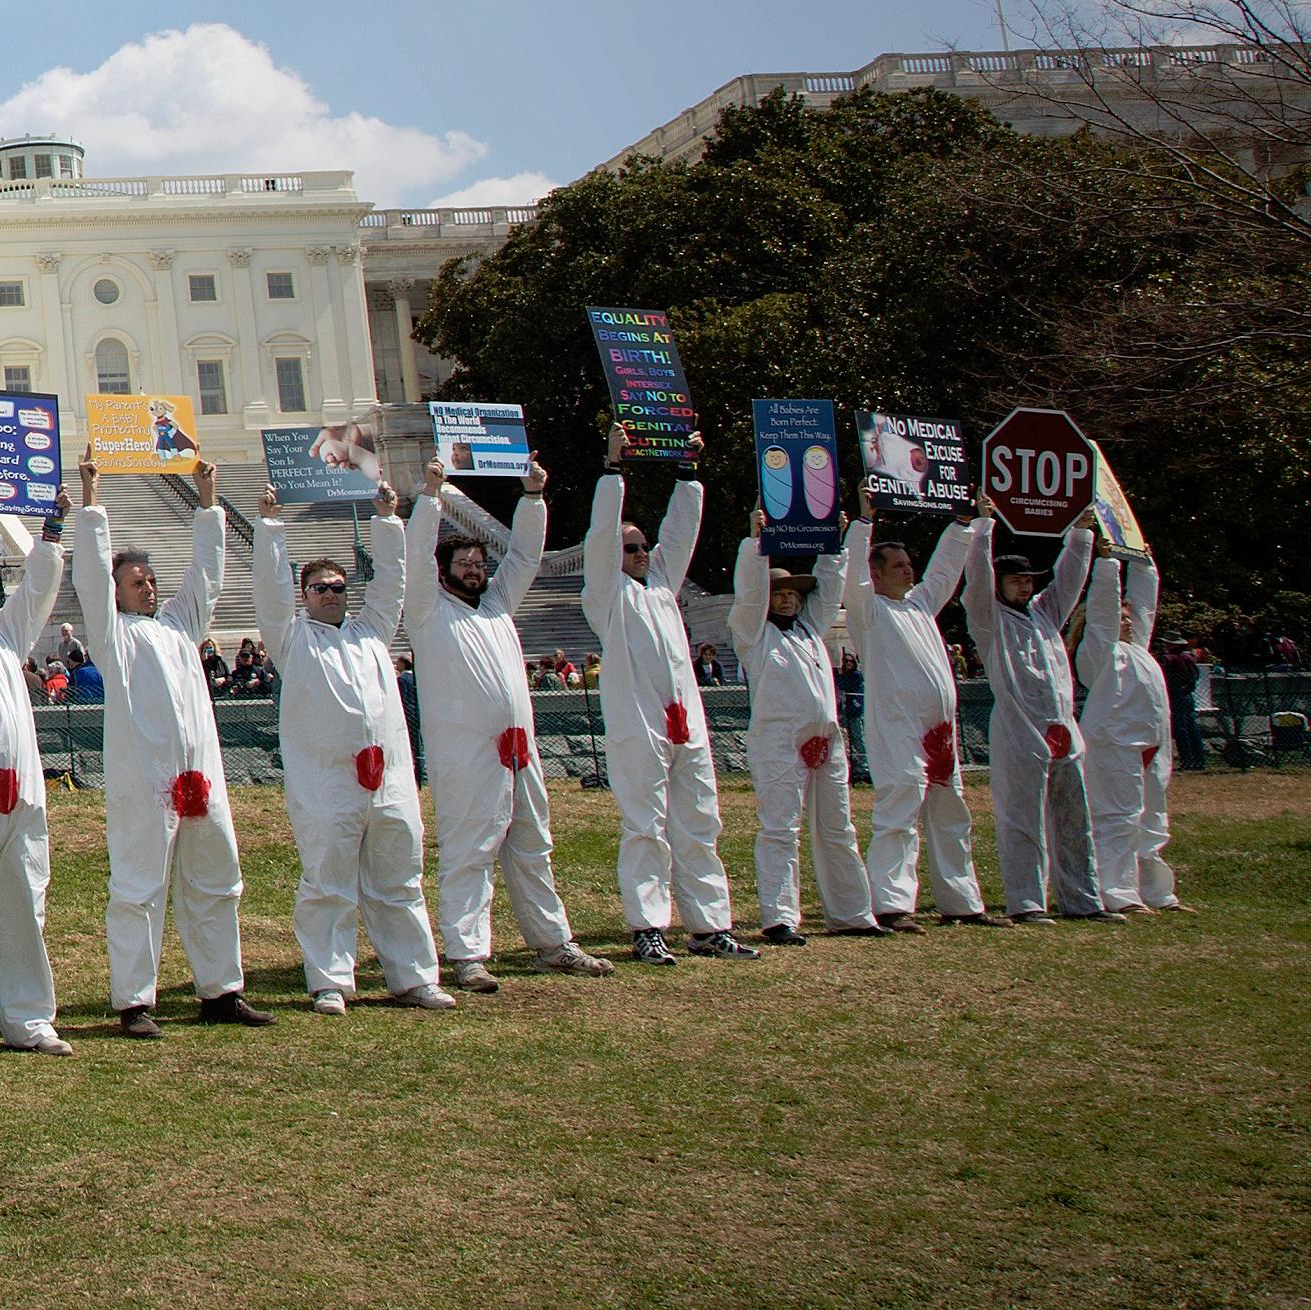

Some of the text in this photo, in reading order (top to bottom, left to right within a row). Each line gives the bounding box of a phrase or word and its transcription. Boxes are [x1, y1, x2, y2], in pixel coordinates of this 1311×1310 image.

[591, 311, 667, 327] EQUALITY
[597, 329, 671, 344] BEGINS AT
[608, 348, 671, 364] BIRTH!
[645, 390, 667, 402] NO
[617, 403, 694, 417] FORCED
[622, 419, 694, 432] GENITAL
[907, 418, 960, 441] MEDICAL
[264, 432, 309, 442] When You
[266, 445, 303, 455] Say Your
[924, 441, 965, 463] EXCUSE
[268, 456, 295, 467] Son Is
[270, 467, 314, 478] PERFECT
[990, 445, 1088, 497] STOP
[273, 480, 330, 490] Do You Mean
[868, 474, 926, 497] GENITAL
[1009, 496, 1068, 508] CIRCUMCISING
[1024, 508, 1054, 517] BABIES
